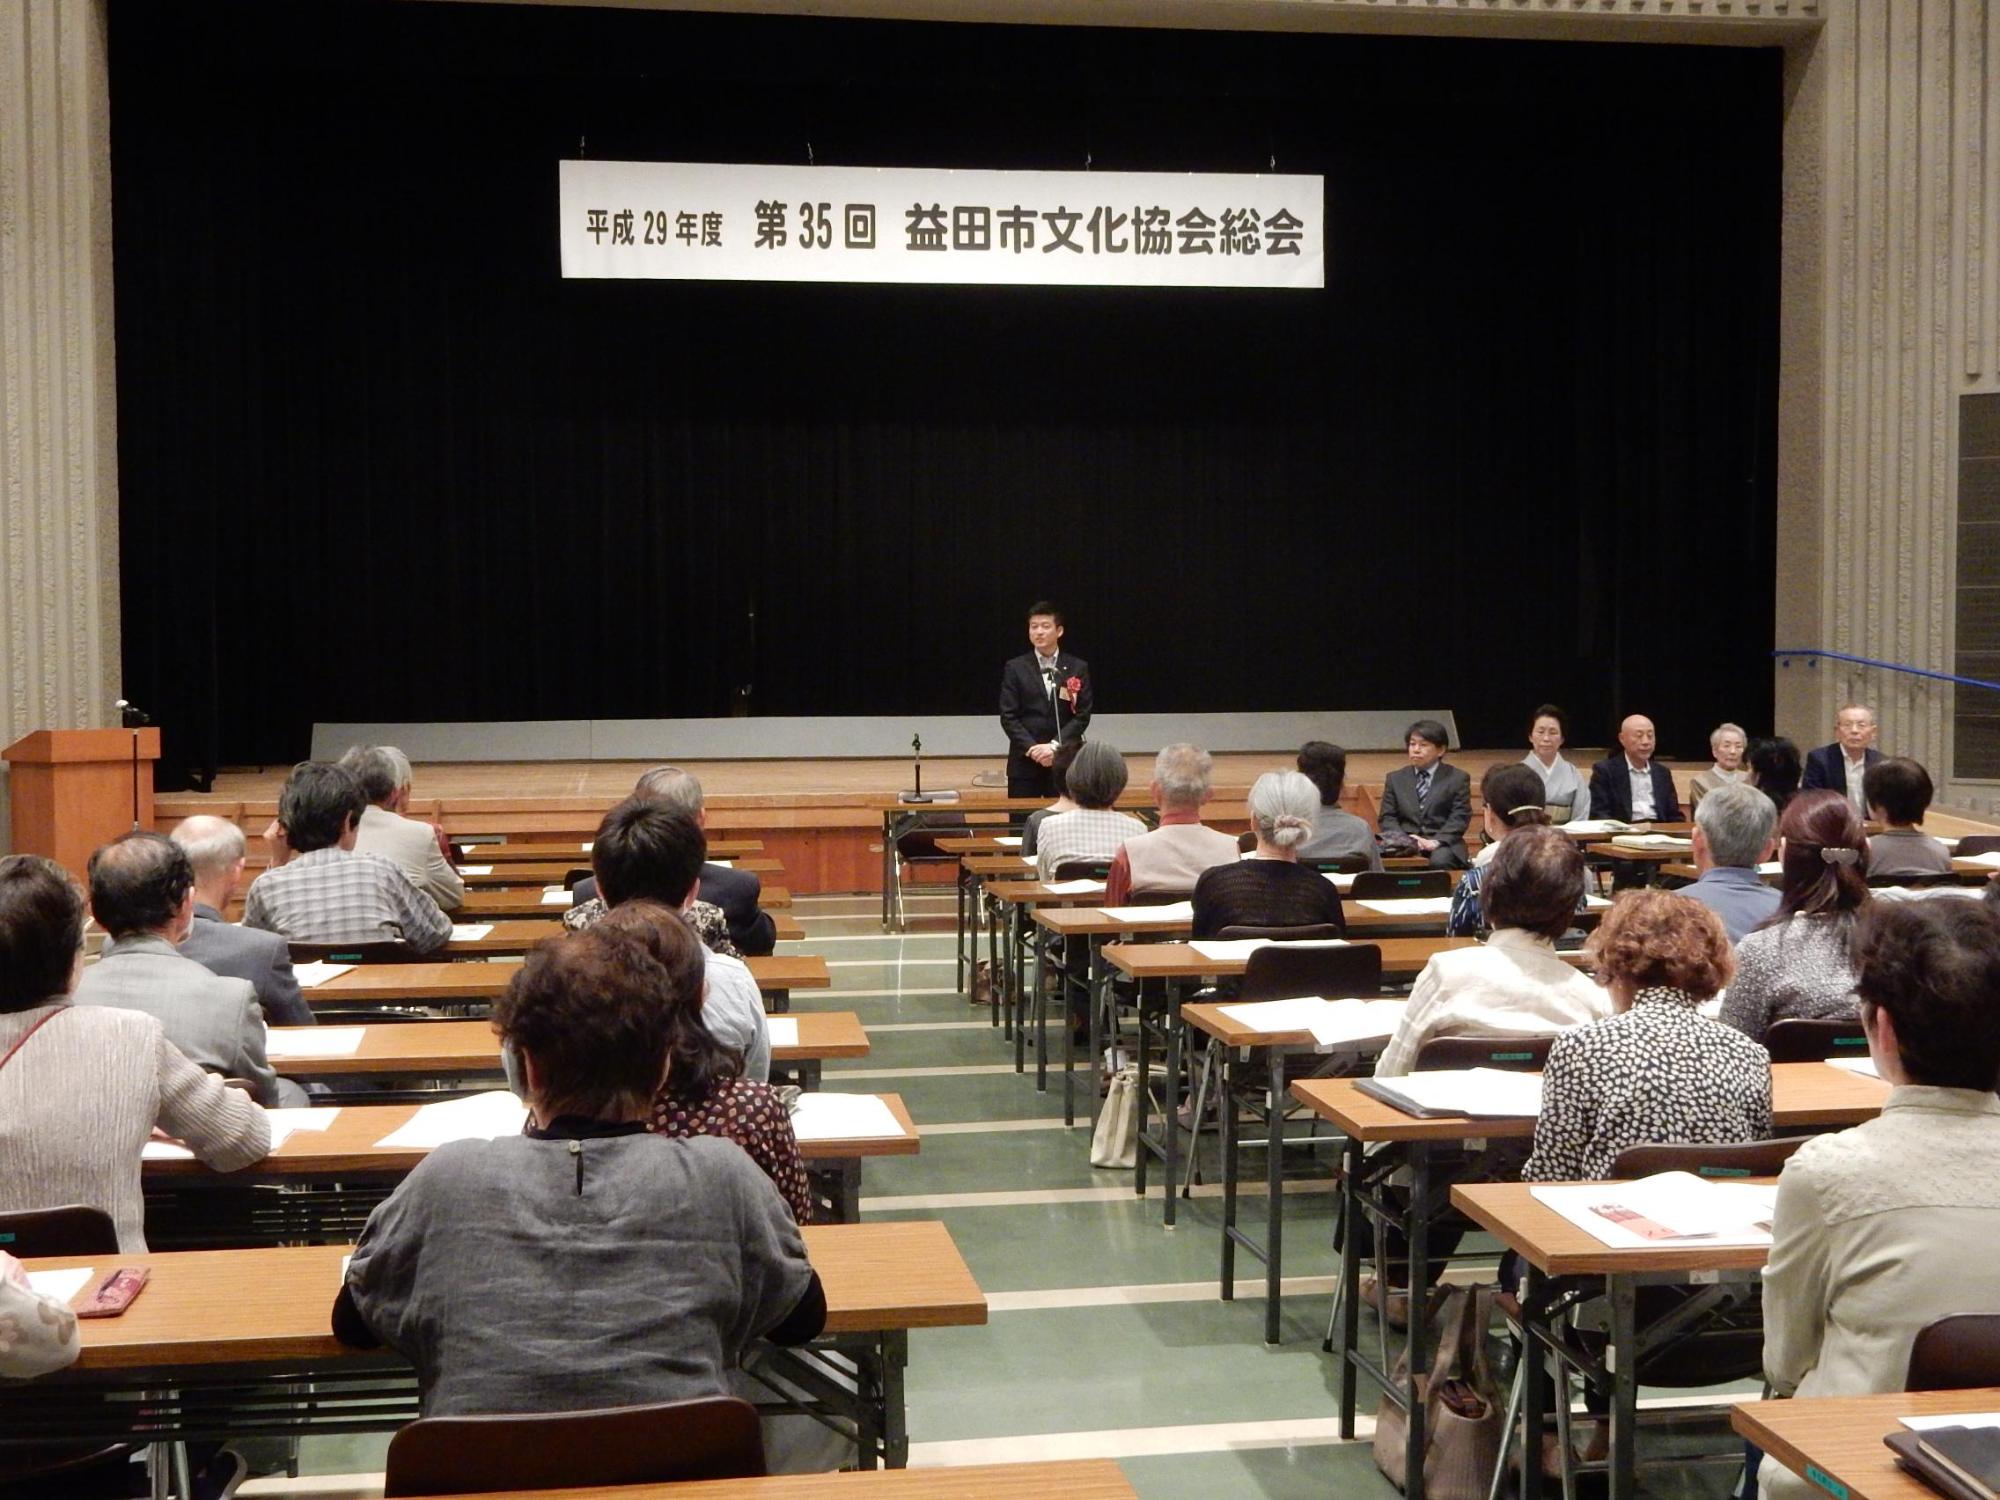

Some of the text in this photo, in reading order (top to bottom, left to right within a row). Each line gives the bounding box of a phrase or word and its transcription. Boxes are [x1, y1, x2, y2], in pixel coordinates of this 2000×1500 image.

[586, 199, 1304, 256] 平成29年度 第35回 益田市文化協会総会
